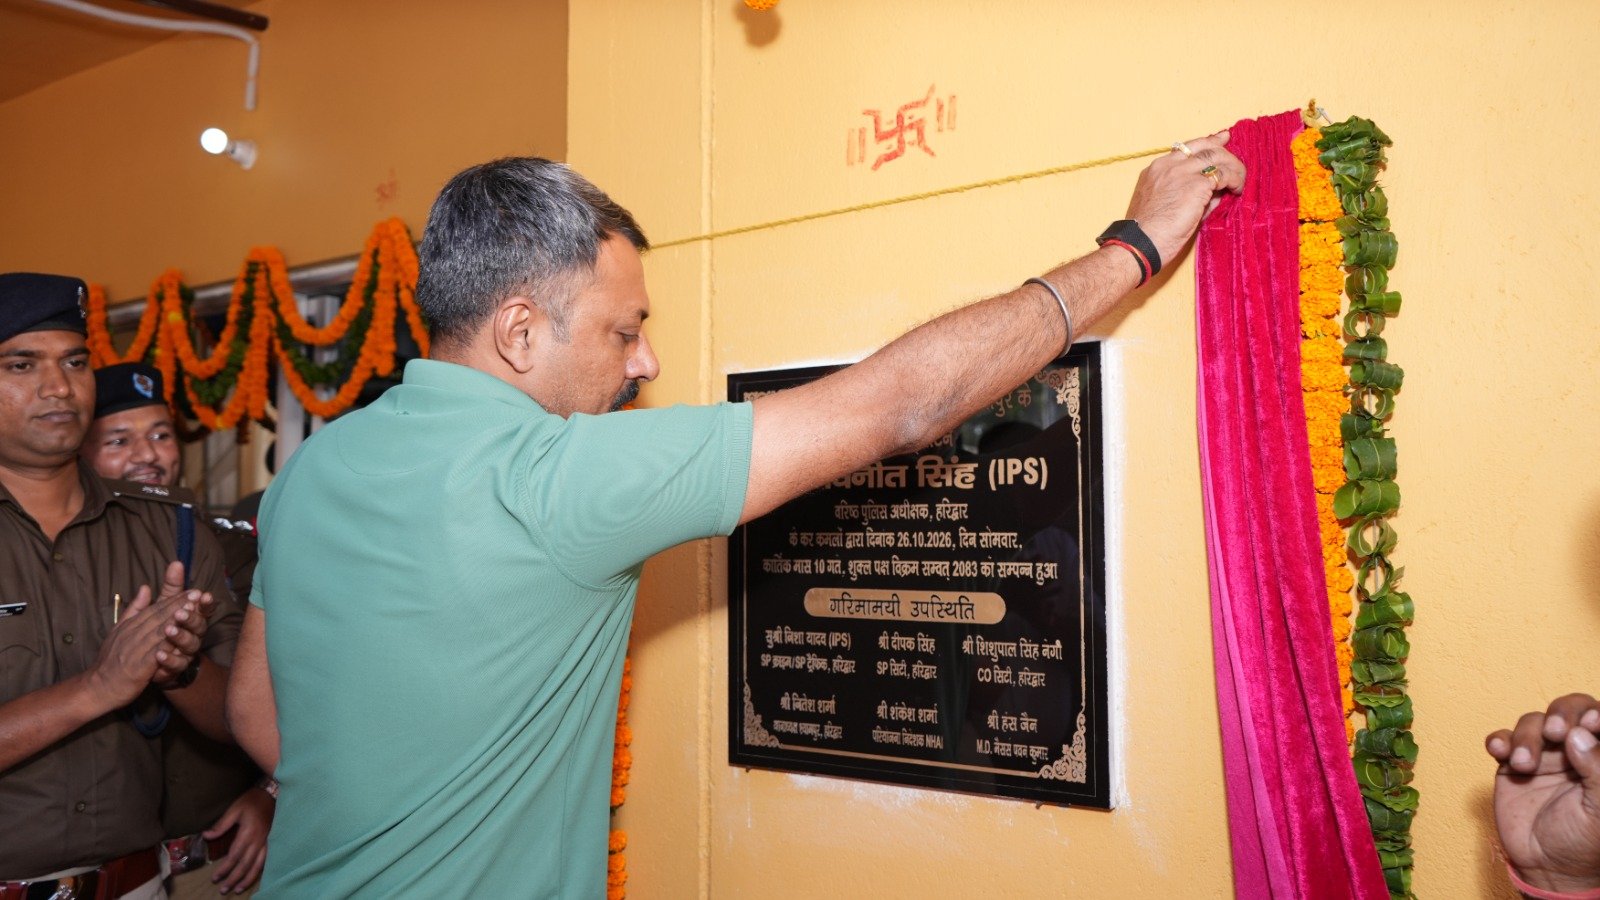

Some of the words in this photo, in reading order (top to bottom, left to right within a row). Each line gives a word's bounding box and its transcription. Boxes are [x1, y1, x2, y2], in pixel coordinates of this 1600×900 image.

[915, 455, 979, 489] सिंह
[989, 457, 1048, 491] (IPS)
[834, 499, 859, 520] वरिष्ठ
[862, 499, 887, 525] पुलिस
[935, 497, 968, 521] हरिद्वार
[800, 531, 813, 547] कर
[845, 531, 863, 549] द्वारा
[959, 526, 976, 548] दिन
[793, 559, 812, 574] मास
[814, 559, 824, 574] 10
[848, 559, 872, 581] शुक्ल
[874, 560, 889, 575] पक्ष
[892, 555, 919, 577] विक्रम
[952, 560, 978, 577] 2083
[997, 561, 1033, 579] सम्पन्न
[1035, 562, 1058, 585] हुआ
[829, 592, 901, 617] गरिमामयी
[910, 595, 975, 620] उपस्थिति
[765, 625, 782, 649] सुश्री
[784, 625, 804, 645] निशा
[806, 631, 826, 646] यादव
[828, 631, 851, 651] (IPS)
[878, 630, 889, 650] श्री
[891, 631, 915, 652] दीपक
[917, 632, 936, 655] सिंह
[962, 635, 974, 655] श्री
[976, 634, 1017, 662] शिशुपाल
[1019, 637, 1039, 660] सिंह
[876, 661, 888, 675] SP
[912, 660, 937, 680] हरिद्वार
[977, 667, 992, 683] CO
[1018, 667, 1046, 687] हरिद्वार
[780, 691, 791, 711] श्री
[817, 694, 836, 715] शर्मा
[876, 700, 888, 720] श्री
[918, 703, 938, 724] शर्मा
[987, 709, 999, 730] श्री
[1001, 711, 1018, 732] हंस
[1020, 711, 1038, 733] जैन
[925, 734, 944, 749] NHAI
[976, 738, 992, 754] M.D.
[1029, 745, 1049, 765] कुमार
